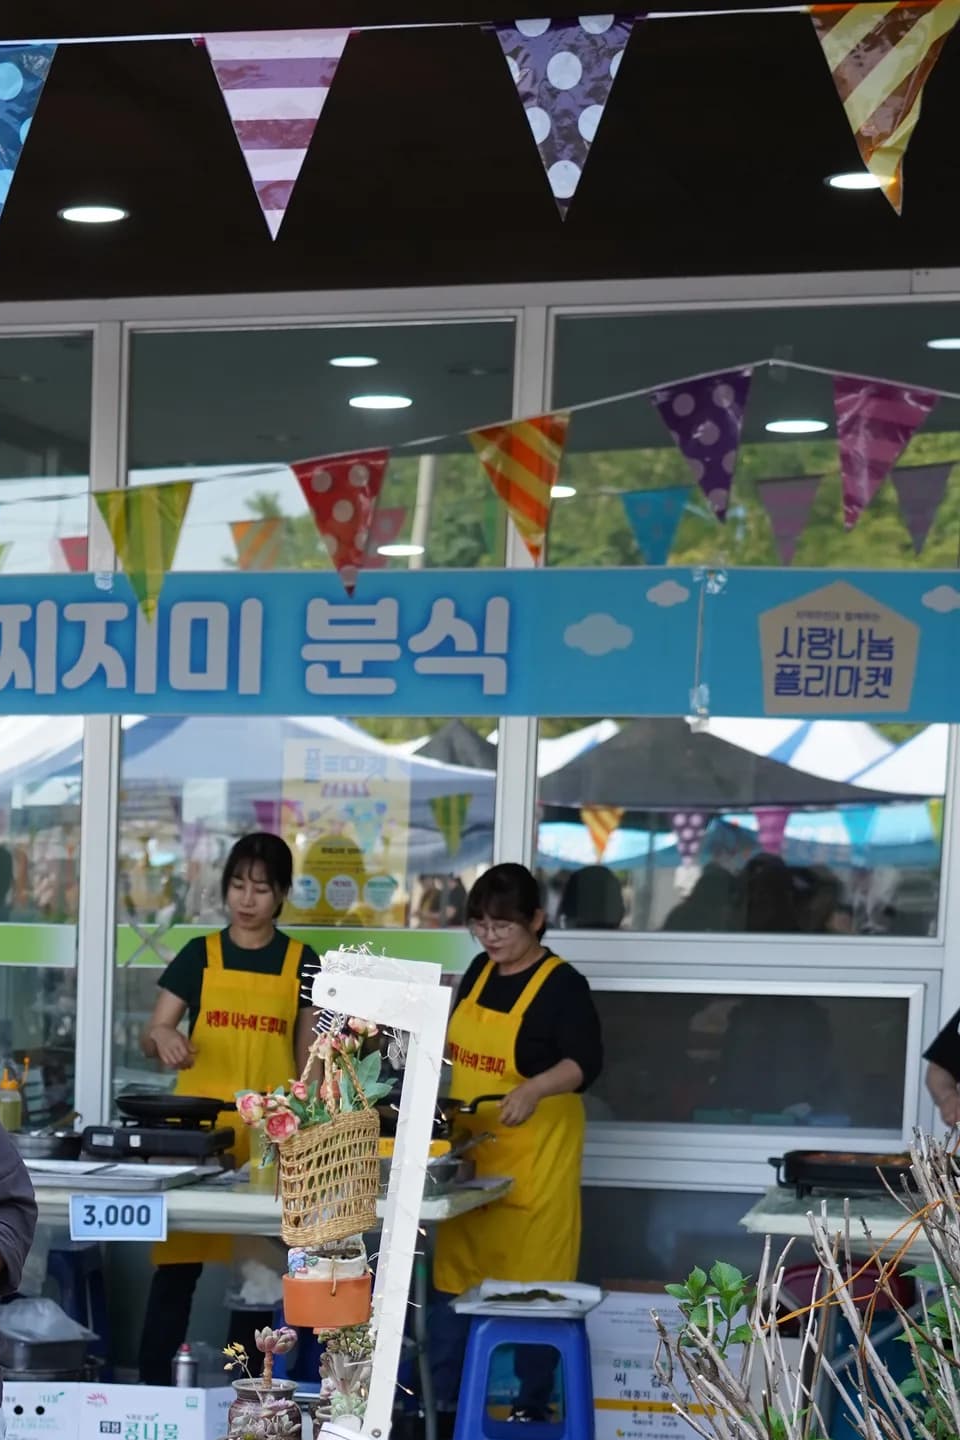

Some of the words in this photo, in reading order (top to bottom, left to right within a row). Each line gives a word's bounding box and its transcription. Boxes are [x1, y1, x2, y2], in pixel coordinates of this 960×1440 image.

[300, 596, 509, 696] 분식
[775, 626, 895, 661] 사랑나눔
[774, 664, 894, 698] 플리마켓
[83, 1204, 151, 1229] 3,000
